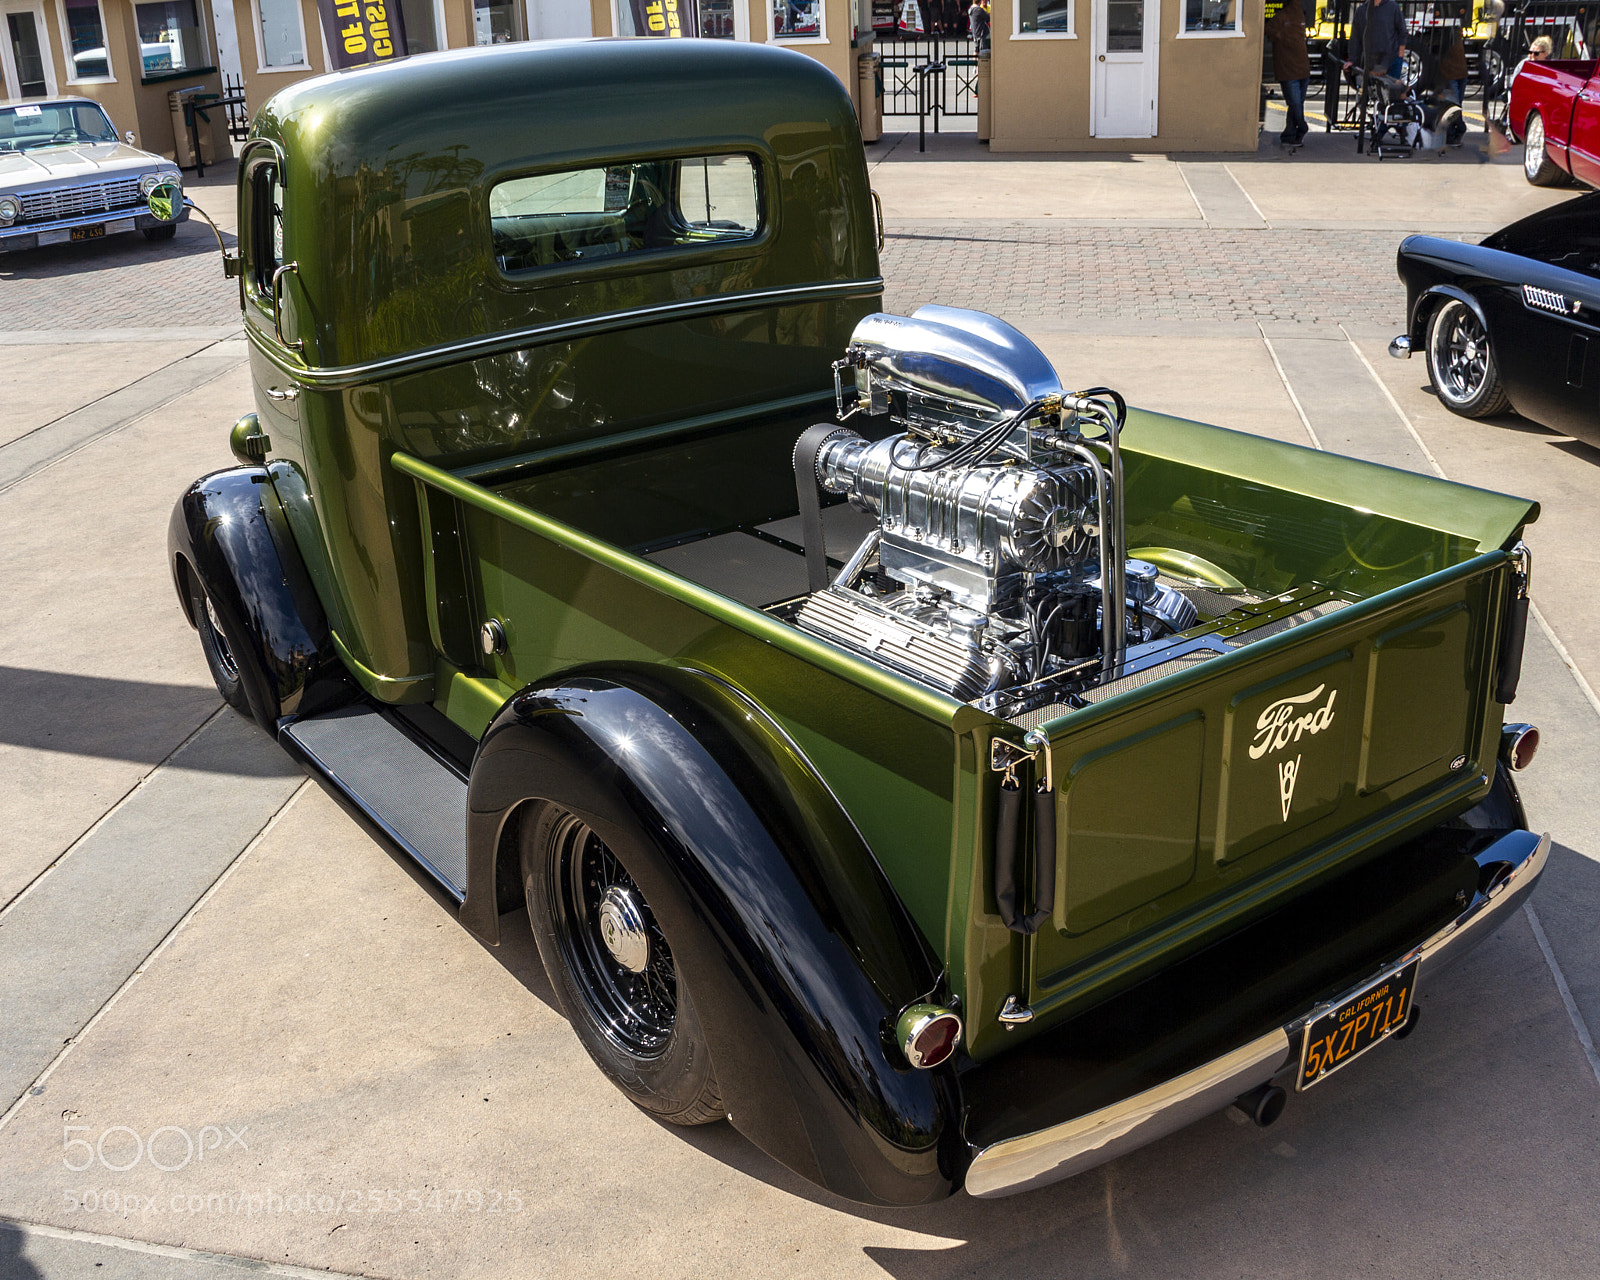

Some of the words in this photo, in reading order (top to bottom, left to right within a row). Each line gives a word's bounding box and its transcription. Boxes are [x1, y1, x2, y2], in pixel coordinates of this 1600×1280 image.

[1248, 683, 1337, 760] Ford
[1305, 987, 1407, 1078] 5XZP711
[1338, 984, 1389, 1022] CALIFORNIA
